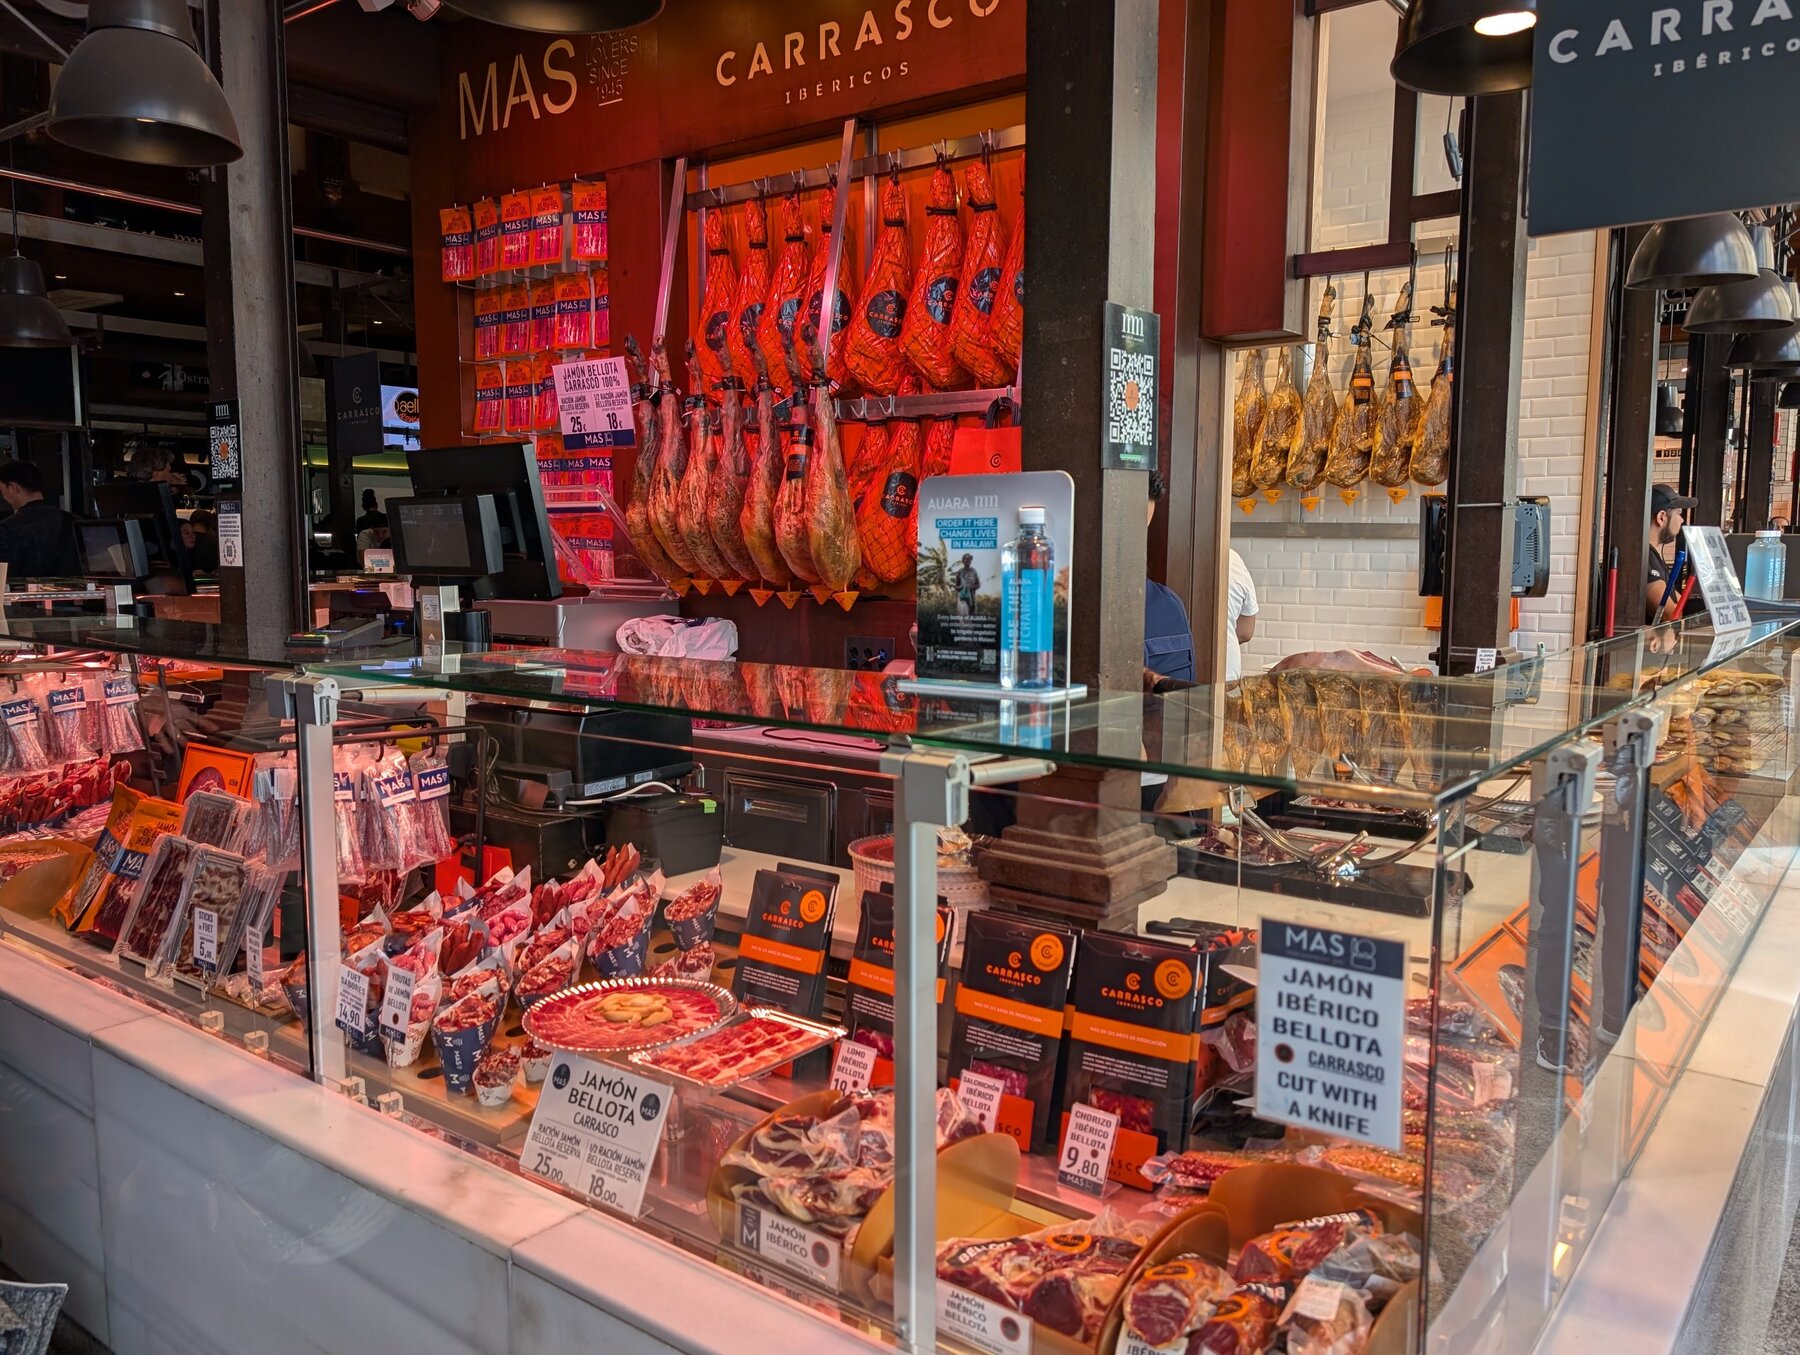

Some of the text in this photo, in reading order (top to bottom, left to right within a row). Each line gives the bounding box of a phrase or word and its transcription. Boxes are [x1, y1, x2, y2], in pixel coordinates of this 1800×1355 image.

[1548, 0, 1794, 64] CARRA
[1653, 38, 1800, 77] IBÉRICO
[589, 59, 629, 84] SINCE
[459, 38, 578, 140] MAS
[785, 61, 910, 104] IBÉRICOS
[536, 214, 552, 225] MAS
[578, 211, 600, 220] MAS
[479, 227, 491, 237] MAS
[505, 221, 521, 231] MAS
[445, 235, 462, 244] MAS
[535, 306, 550, 316] MAS
[560, 300, 578, 310] MAS
[479, 314, 492, 324] MAS
[506, 311, 520, 320] MAS
[563, 362, 618, 380] JAMÓN BELLOTA
[508, 386, 522, 394] MAS
[564, 375, 621, 392] CARRASCO 100%
[481, 389, 494, 397] MAS
[337, 407, 380, 420] CARRASCO
[584, 432, 604, 444] MAS
[589, 458, 611, 467] MAS
[928, 498, 970, 510] AUARA
[937, 518, 996, 528] ORDER IT HERE.
[940, 529, 996, 538] CHANGE LIVES
[952, 540, 995, 548] IN MALAWI.
[53, 692, 75, 704] MAS
[106, 684, 128, 695] MAS
[6, 703, 29, 716] MAS
[421, 774, 442, 788] MAS
[122, 853, 144, 871] MA
[762, 912, 804, 929] CARRASCO
[1286, 926, 1344, 957] MAS
[347, 970, 361, 982] FUET
[392, 972, 411, 986] VIRUTAS
[986, 964, 1041, 984] CARRASCO
[1283, 966, 1373, 1000] JAMÓN
[340, 977, 366, 996] SABORES
[388, 998, 407, 1012] BELLOTA
[1101, 988, 1163, 1008] CARRASCO
[340, 1003, 360, 1027] 14,90
[1277, 990, 1380, 1028] IBÉRICO
[1272, 1016, 1382, 1058] BELLOTA
[847, 1046, 866, 1058] LOMO
[836, 1064, 864, 1080] BELLOTA
[841, 1056, 868, 1070] IBÉRICO
[1308, 1050, 1385, 1082] CARRASCO
[554, 1075, 568, 1087] MAS
[579, 1070, 638, 1102] JAMÓN
[963, 1076, 1000, 1092] SALCHICHÓN
[966, 1086, 994, 1102] IBÉRICO
[1278, 1071, 1377, 1110] CUT WITH
[568, 1088, 635, 1126] BELLOTA
[641, 1107, 657, 1118] MAS
[962, 1097, 991, 1112] BELLOTA
[573, 1112, 620, 1139] CARRASCO
[1075, 1110, 1112, 1128] CHORIZO
[1288, 1100, 1370, 1136] A KNIFE
[538, 1124, 582, 1148] RACIÓN JAMÓN
[1075, 1122, 1110, 1140] IBÉRICO
[532, 1132, 556, 1150] BELLOTA
[556, 1141, 581, 1160] RESERVA
[1070, 1132, 1106, 1151] BELLOTA
[590, 1143, 646, 1170] 1/2 RACIÓN JAMÓN
[1066, 1146, 1100, 1178] 9,80
[533, 1152, 564, 1183] 25,00
[586, 1154, 612, 1174] BELLOTA
[614, 1162, 642, 1183] RESERVA
[588, 1174, 618, 1204] 18,00
[1066, 1174, 1084, 1186] MAS
[742, 1225, 758, 1250] M
[768, 1219, 806, 1243] JAMÓN
[766, 1232, 808, 1258] IBÉRICO
[950, 1290, 985, 1310] JAMÓN
[946, 1299, 987, 1322] IBÉRICO
[944, 1309, 988, 1335] BELLOTA
